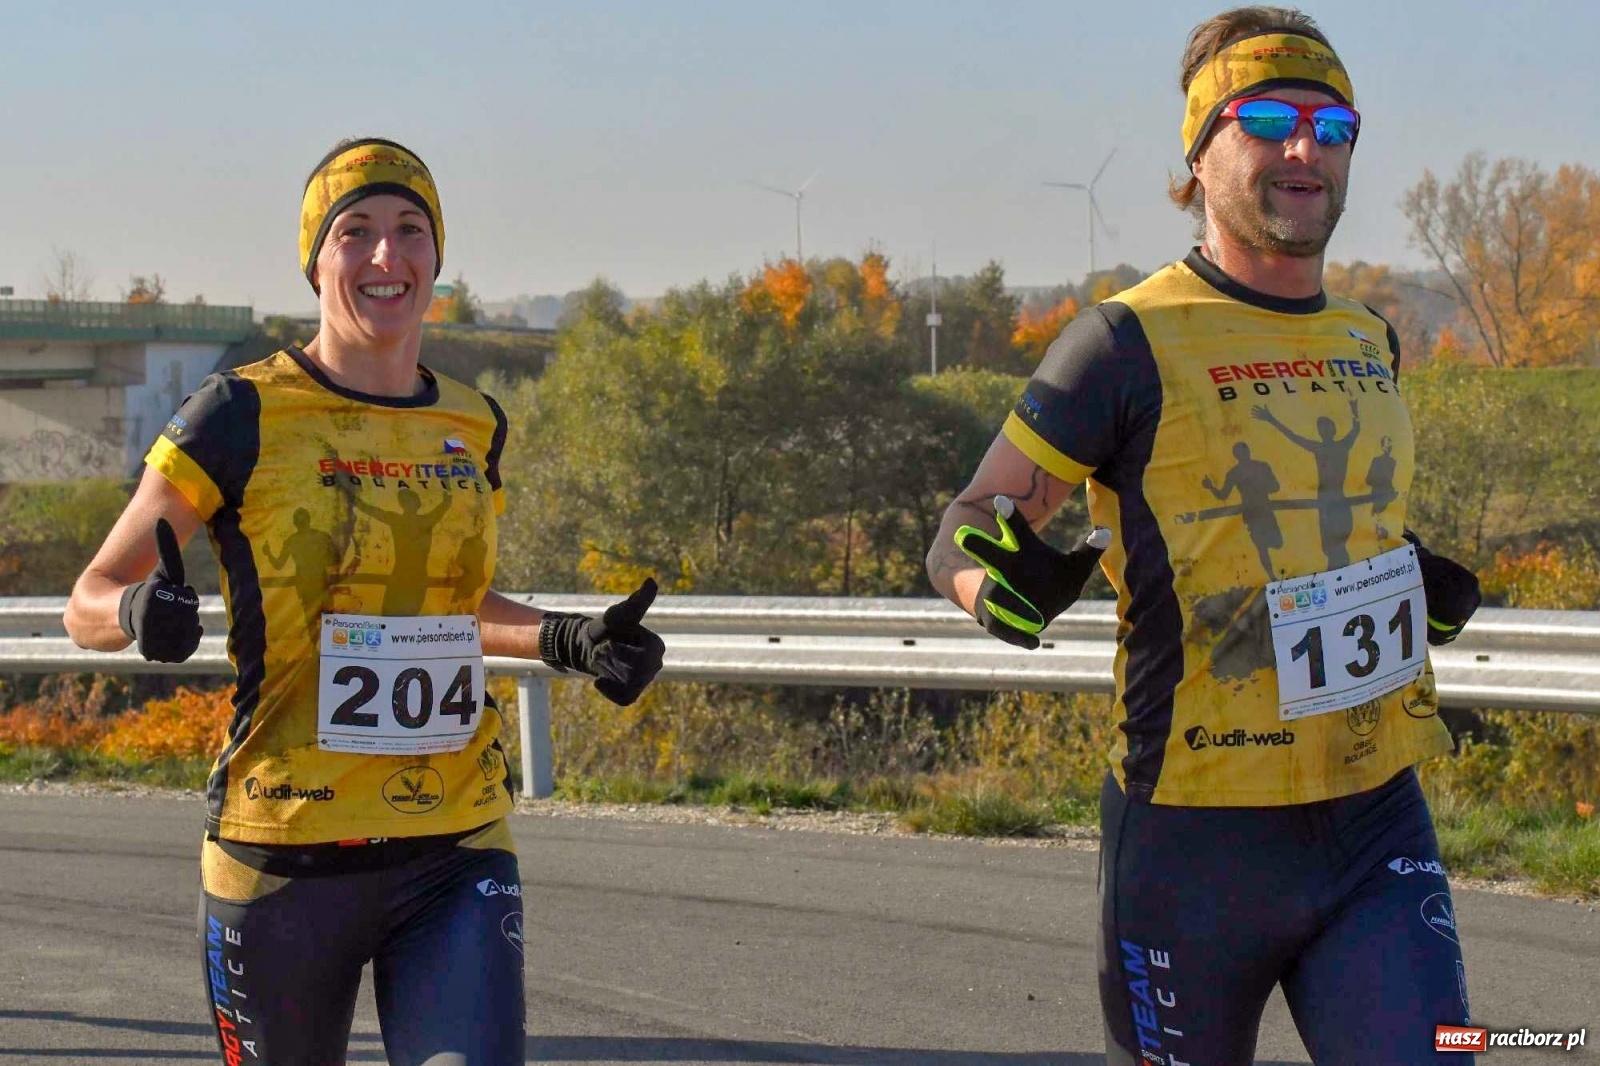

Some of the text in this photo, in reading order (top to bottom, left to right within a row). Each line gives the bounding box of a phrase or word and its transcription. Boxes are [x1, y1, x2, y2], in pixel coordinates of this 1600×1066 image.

[1208, 360, 1325, 384] ENERGY
[1332, 359, 1391, 380] TEAM
[319, 459, 414, 478] ENERGY
[421, 463, 476, 479] TEAM
[322, 475, 483, 494] BOLATICE
[1334, 562, 1415, 597] www.personalbest.pl
[391, 630, 475, 645] www.personalbest.pl
[1290, 599, 1413, 689] 131
[330, 665, 477, 729] 204
[1184, 725, 1295, 750] Audit-web
[245, 777, 335, 801] Audit-web
[207, 915, 231, 1005] TEAM
[1120, 938, 1161, 1049] TEAM
